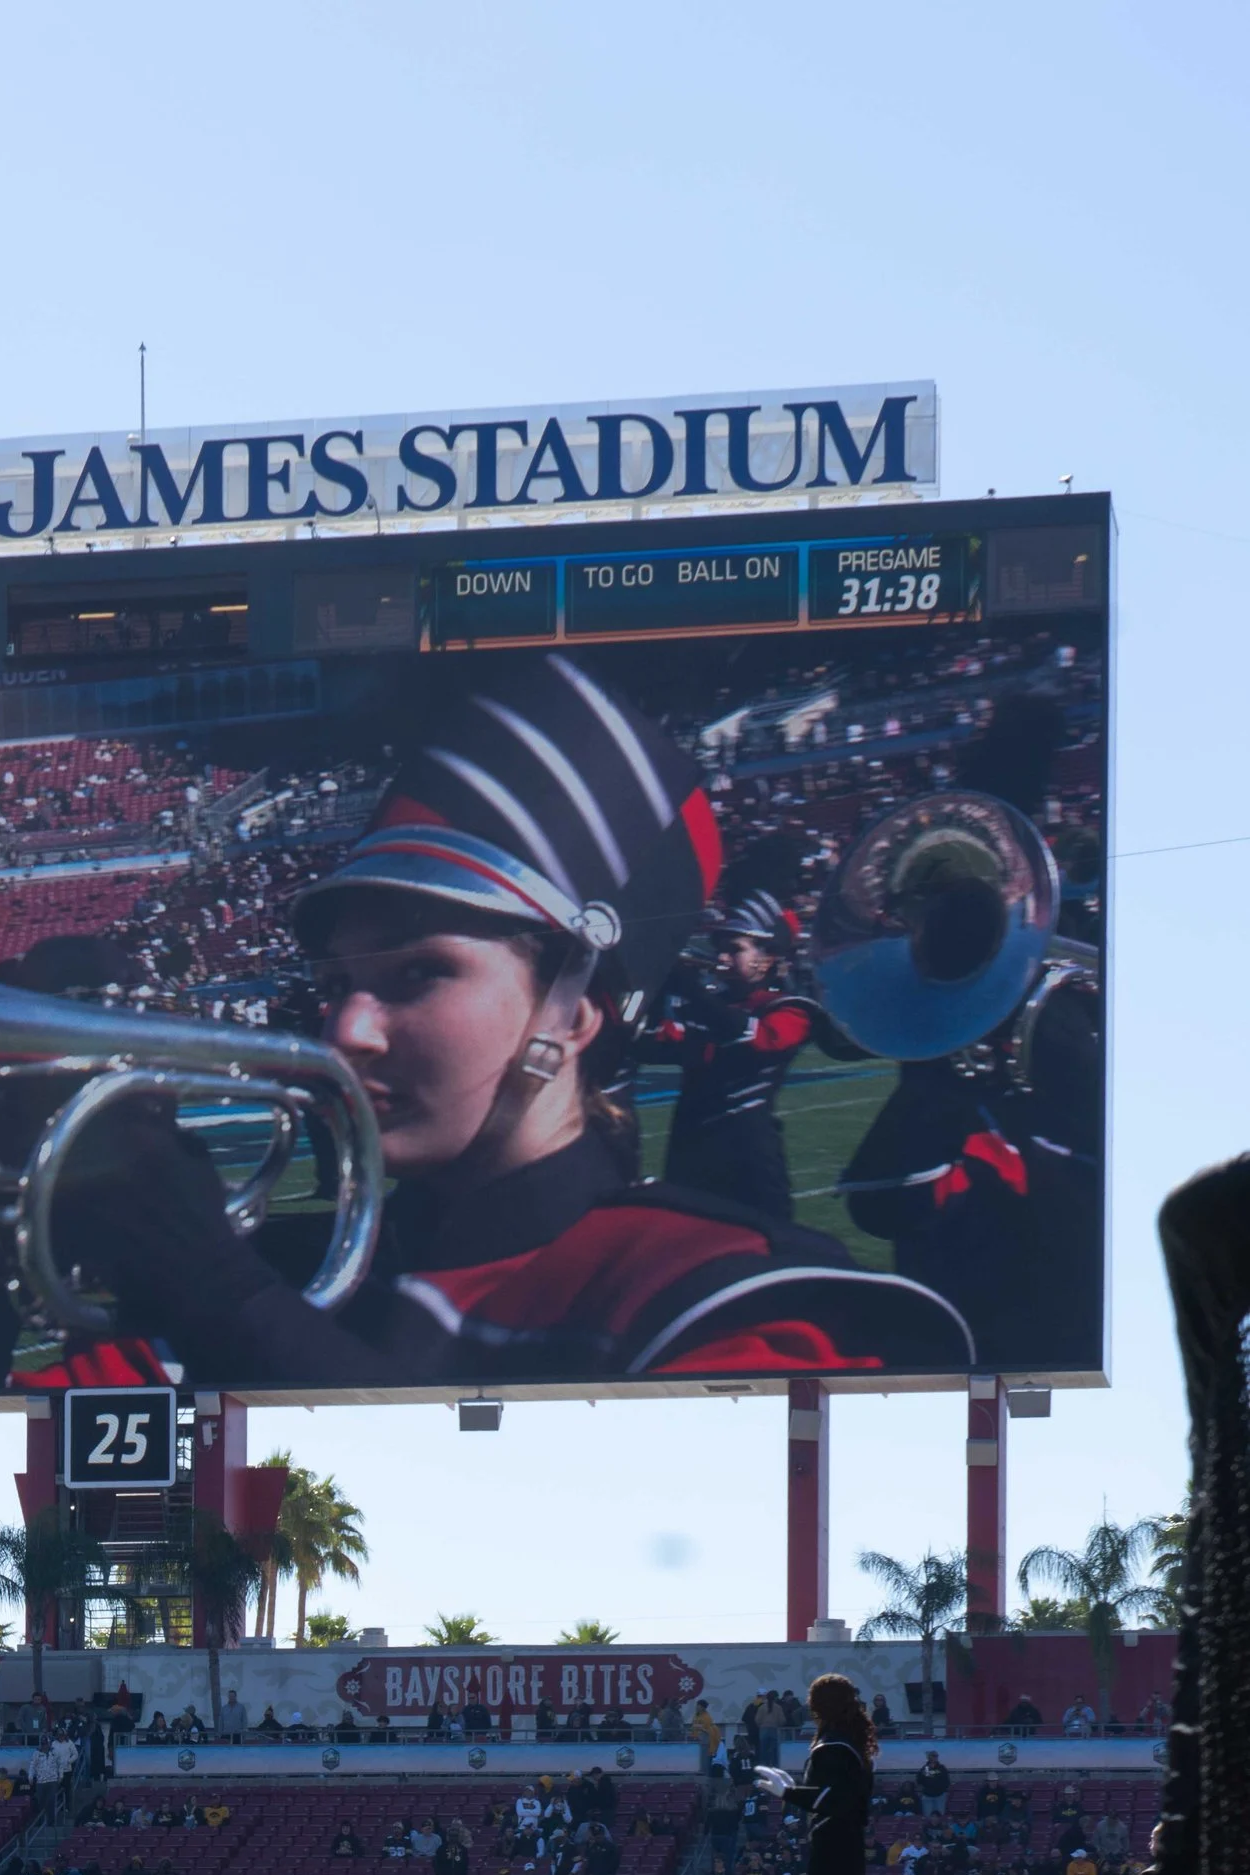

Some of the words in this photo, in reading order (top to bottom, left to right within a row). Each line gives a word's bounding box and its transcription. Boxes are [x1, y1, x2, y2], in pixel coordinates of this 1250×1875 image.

[396, 395, 918, 513] STADIUM
[583, 566, 614, 589] TO
[620, 564, 653, 587] GO
[677, 559, 738, 584] BALL
[744, 556, 780, 580] ON
[837, 547, 941, 573] PREGAME
[455, 571, 531, 597] DOWN
[837, 574, 941, 616] 31:38
[87, 1413, 151, 1464] 25
[561, 1663, 654, 1705] BITES
